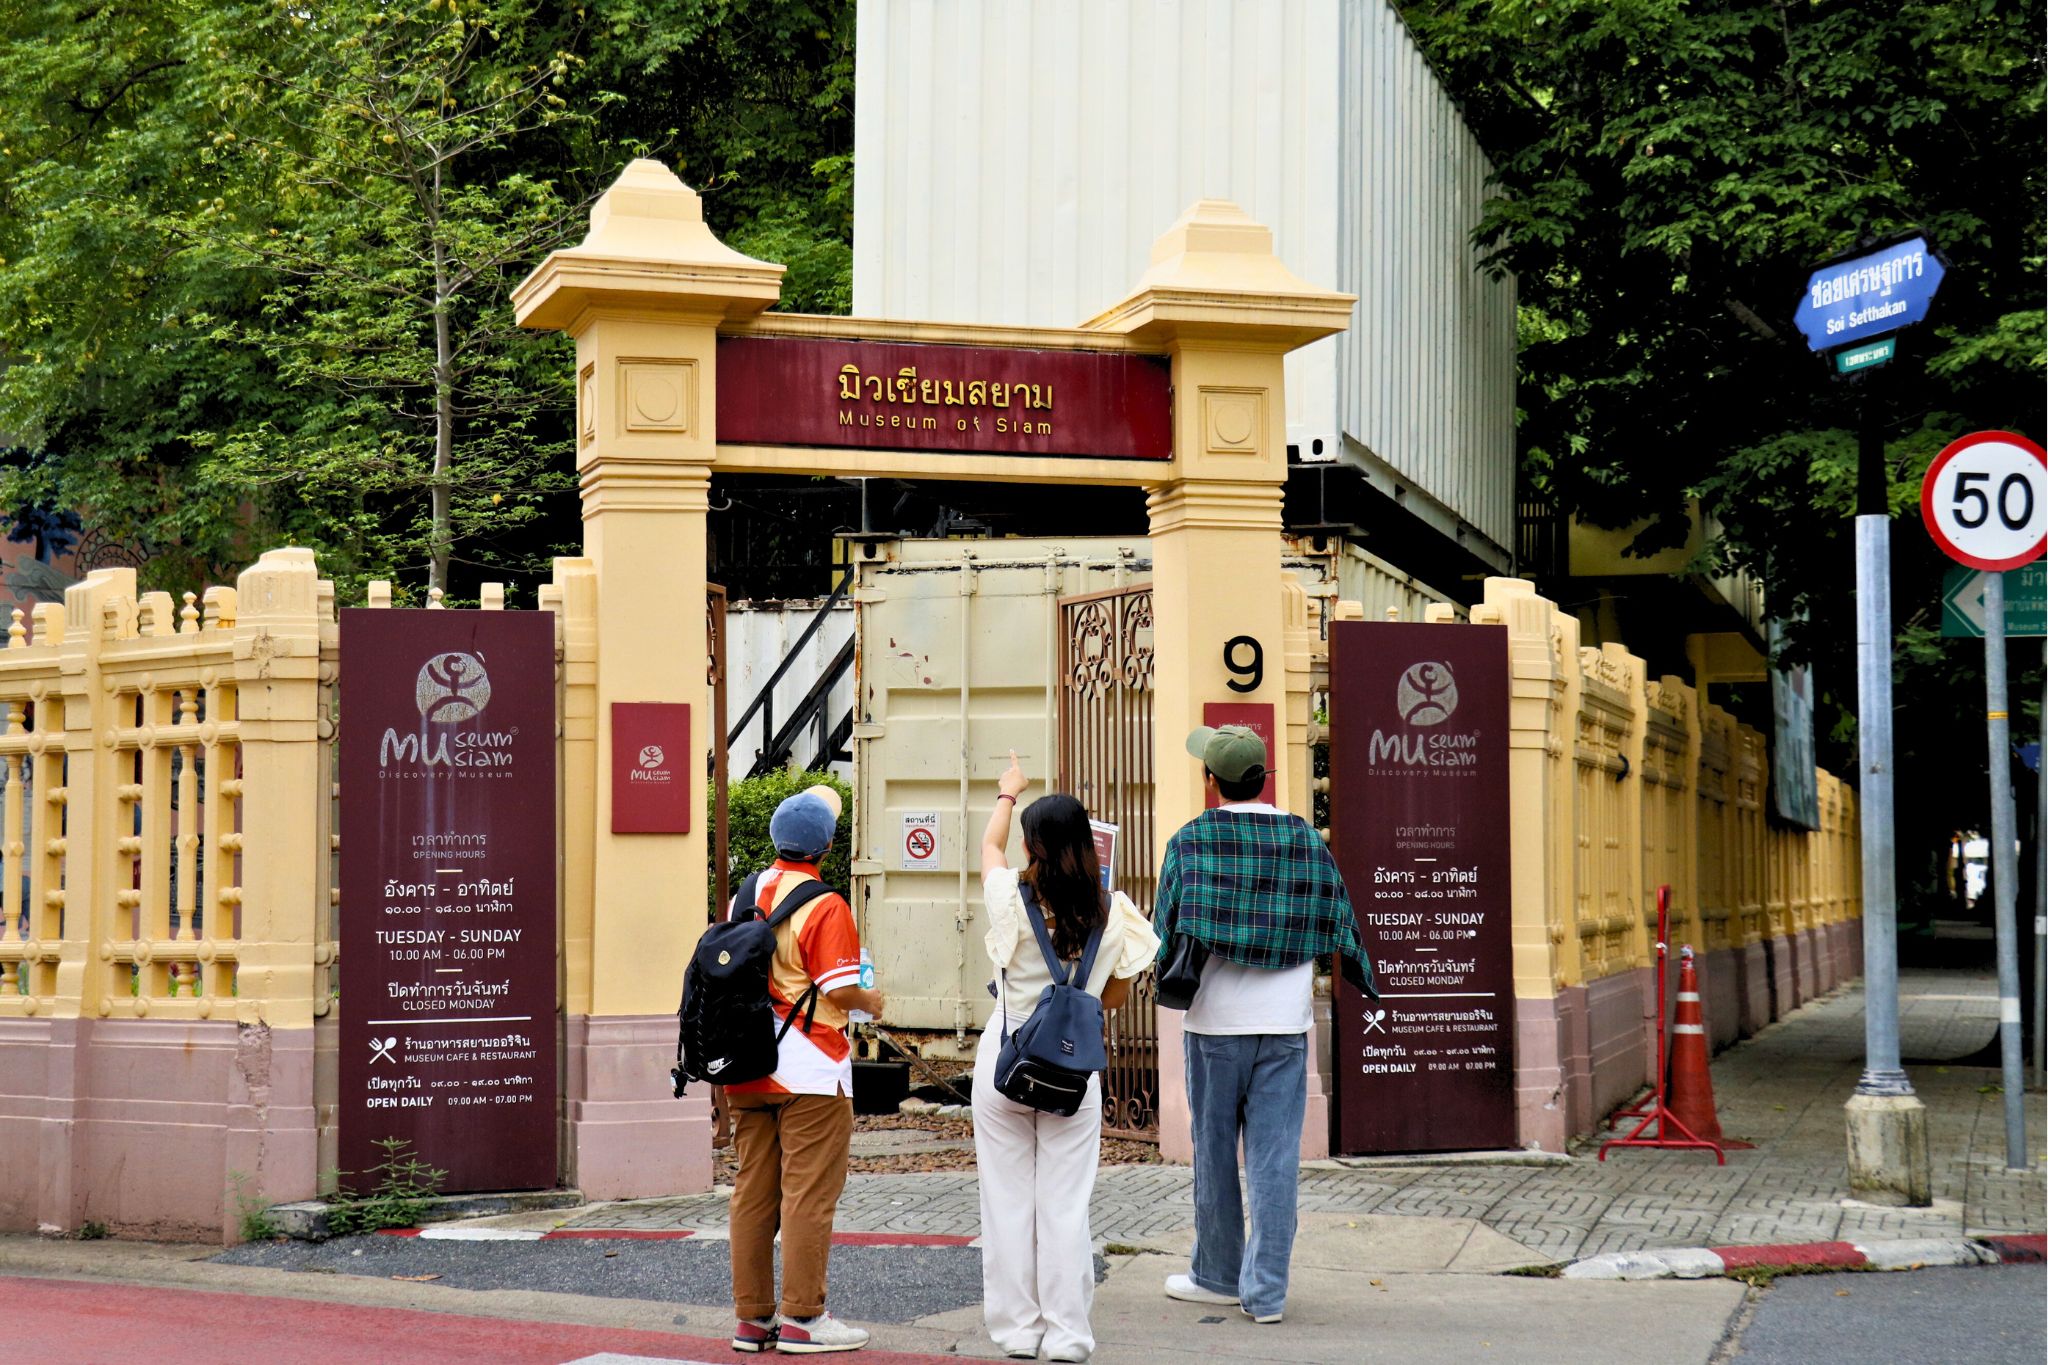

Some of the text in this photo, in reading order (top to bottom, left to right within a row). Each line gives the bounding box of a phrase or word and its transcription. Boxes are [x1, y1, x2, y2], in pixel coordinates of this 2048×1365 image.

[1811, 252, 1923, 309] ซอยเศรษฐการ
[1826, 300, 1907, 335] Soi Setthakan
[838, 363, 1053, 411] มิวเซียมสยาม
[839, 411, 1052, 436] Museum of Siam
[1952, 472, 2034, 532] 50
[1223, 635, 1264, 693] 9
[379, 771, 453, 779] Discovery
[1368, 768, 1477, 777] Discovery Museum
[1395, 823, 1456, 837] เวลาทำการ
[412, 830, 487, 846] เวลาทำการ
[1396, 841, 1455, 849] OPENING HOURS
[413, 850, 486, 859] OPENING HOURS
[1374, 867, 1415, 884] อังคาร
[1432, 866, 1478, 883] อาทิตย์
[385, 879, 436, 898] อังคาร
[457, 877, 515, 897] อาทิตย์
[1446, 886, 1477, 898] นาฬิกา
[476, 900, 513, 914] นาฬิกา
[1367, 913, 1423, 926] TUESDAY
[1434, 913, 1485, 925] SUNDAY
[375, 930, 446, 944] TUESDAY
[460, 929, 522, 943] SUNDAY
[1379, 931, 1403, 940] 10.00
[1405, 931, 1420, 940] AM
[1429, 930, 1454, 940] 06.00
[1456, 930, 1472, 939] PM
[389, 950, 420, 961] 10.00
[423, 950, 441, 960] AM
[453, 949, 484, 960] 06.00
[487, 948, 505, 959] PM
[1378, 958, 1476, 974] ปิดทำการวันจันทร์
[1390, 975, 1465, 986] CLOSED MONDAY
[388, 979, 510, 998] ปิดทำการวันจันทร์
[402, 999, 496, 1011] CLOSED MONDAY
[1392, 1025, 1424, 1034] MUSEUM
[1425, 1025, 1445, 1033] CAFE
[1453, 1024, 1499, 1032] RESTAURANT
[404, 1050, 537, 1063] MUSEUM CAFE & RESTAURANT
[1362, 1045, 1407, 1060] เปิดทุกวัน
[707, 1057, 725, 1070] NIKE
[1362, 1061, 1496, 1074] OPEN DAILY 09.00 AM 07.00 PM
[367, 1075, 421, 1093] เปิดทุกวัน
[367, 1098, 398, 1109] OPEN
[401, 1097, 434, 1108] DAILY
[448, 1097, 471, 1106] 09.00
[473, 1096, 487, 1105] AM
[495, 1095, 517, 1104] 07.00
[519, 1094, 533, 1103] PM
